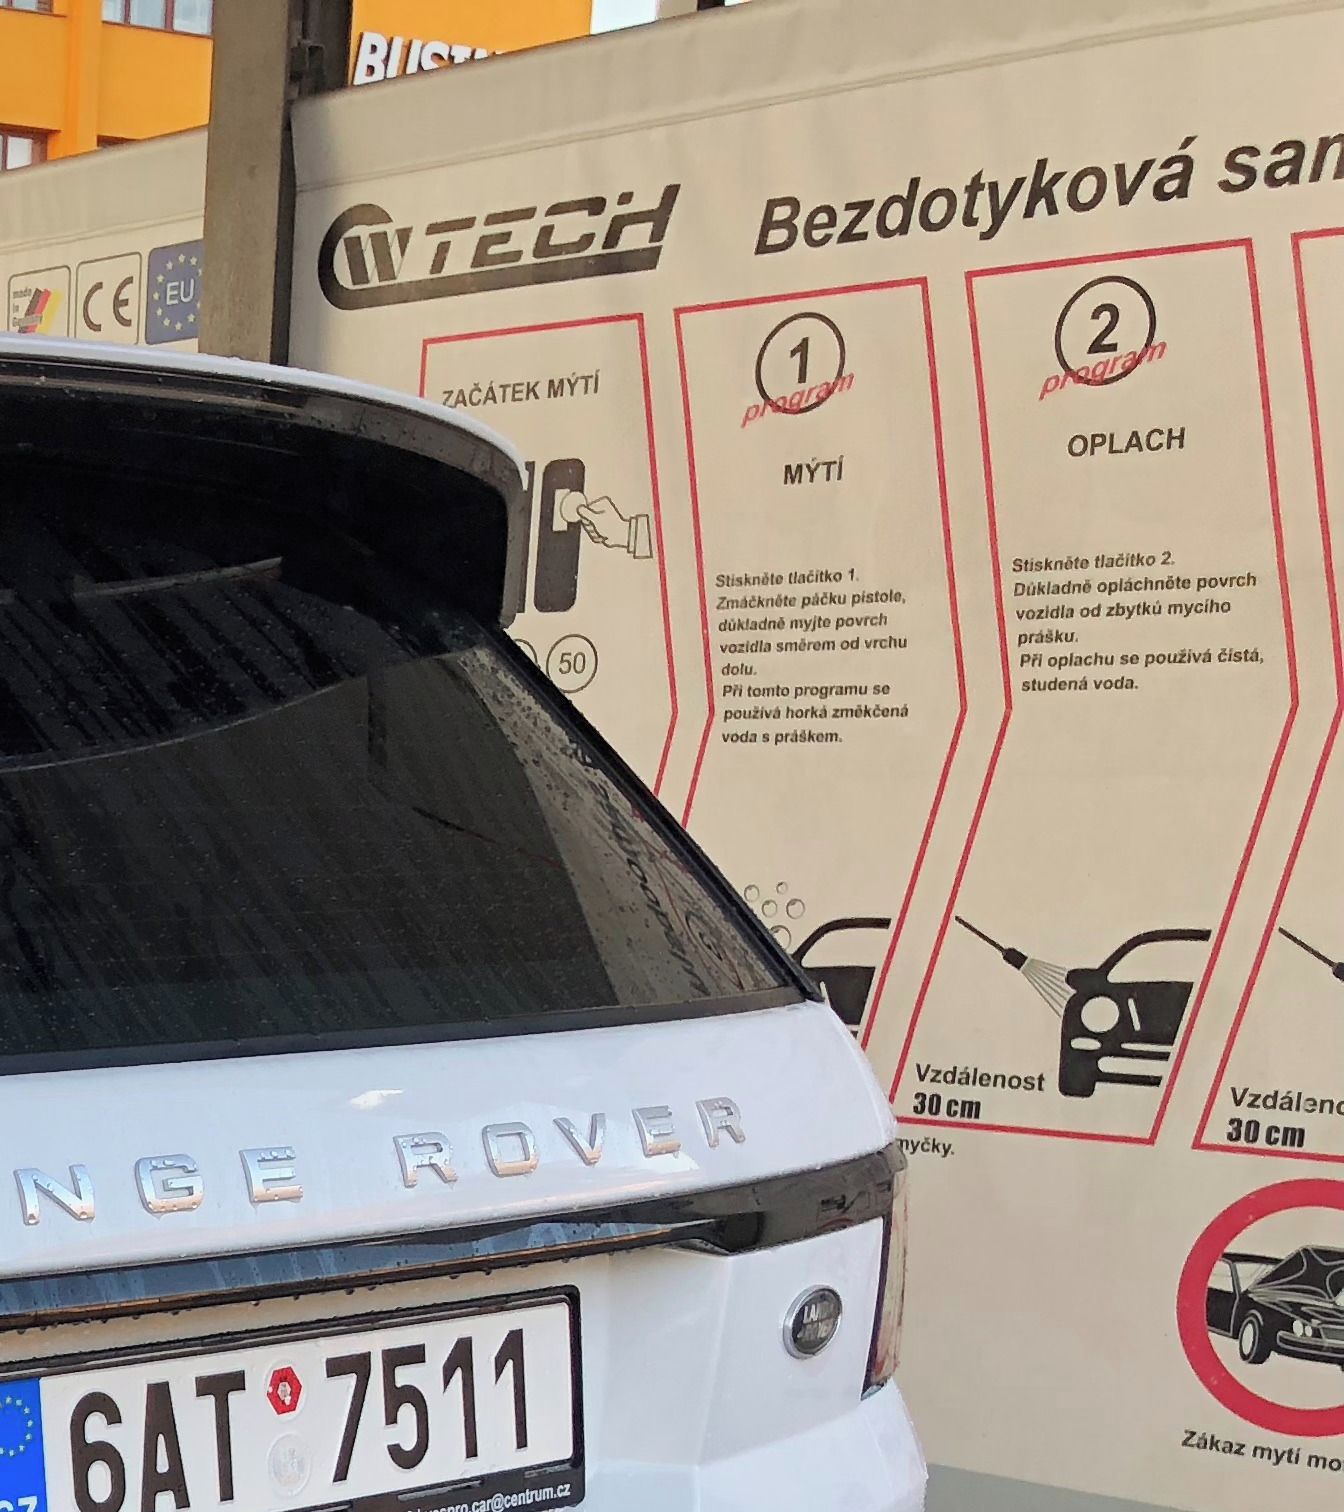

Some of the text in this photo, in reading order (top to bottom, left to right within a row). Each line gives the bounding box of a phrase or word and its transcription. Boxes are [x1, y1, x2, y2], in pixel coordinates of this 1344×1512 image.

[754, 136, 1199, 255] Bezdotyková
[83, 275, 134, 332] CE
[166, 278, 194, 306] EU
[1087, 303, 1120, 355] 2
[789, 337, 809, 384] 1
[1038, 338, 1168, 401] program
[442, 369, 600, 409] ZAČÁTEK MÝTÍ
[740, 369, 855, 428] program
[1067, 426, 1187, 457] OPLACH
[783, 455, 844, 486] MÝTÍ
[1012, 550, 1176, 573] Stiskněte tlačítko 2.
[715, 568, 860, 588] Stiskněte tlačítko 1.
[1096, 576, 1191, 597] opláchněte
[1196, 572, 1257, 592] povrch
[801, 591, 847, 610] páčku
[1016, 598, 1232, 621] vozidla od zbytků mycího
[789, 614, 832, 633] myjte
[835, 612, 888, 631] povrch
[719, 635, 908, 654] vozidla směrem od vrchu
[1017, 630, 1079, 647] prášku.
[558, 651, 587, 675] 50
[721, 662, 758, 676] dolu.
[1020, 652, 1043, 668] Při
[1047, 651, 1115, 671] oplachu
[1119, 653, 1140, 666] se
[722, 682, 890, 700] Při tomto programu se
[1021, 676, 1140, 693] studená voda.
[785, 704, 828, 720] horká
[831, 703, 909, 720] změkčená
[722, 729, 758, 744] voda
[761, 732, 770, 744] s
[915, 1063, 1045, 1092] Vzdálenost
[913, 1092, 982, 1120] 30 cm
[391, 1093, 747, 1188] ROVER
[1226, 1117, 1305, 1149] 30 cm
[325, 1328, 530, 1484] 7511
[1180, 1429, 1344, 1472] Zákaz mytí mo
